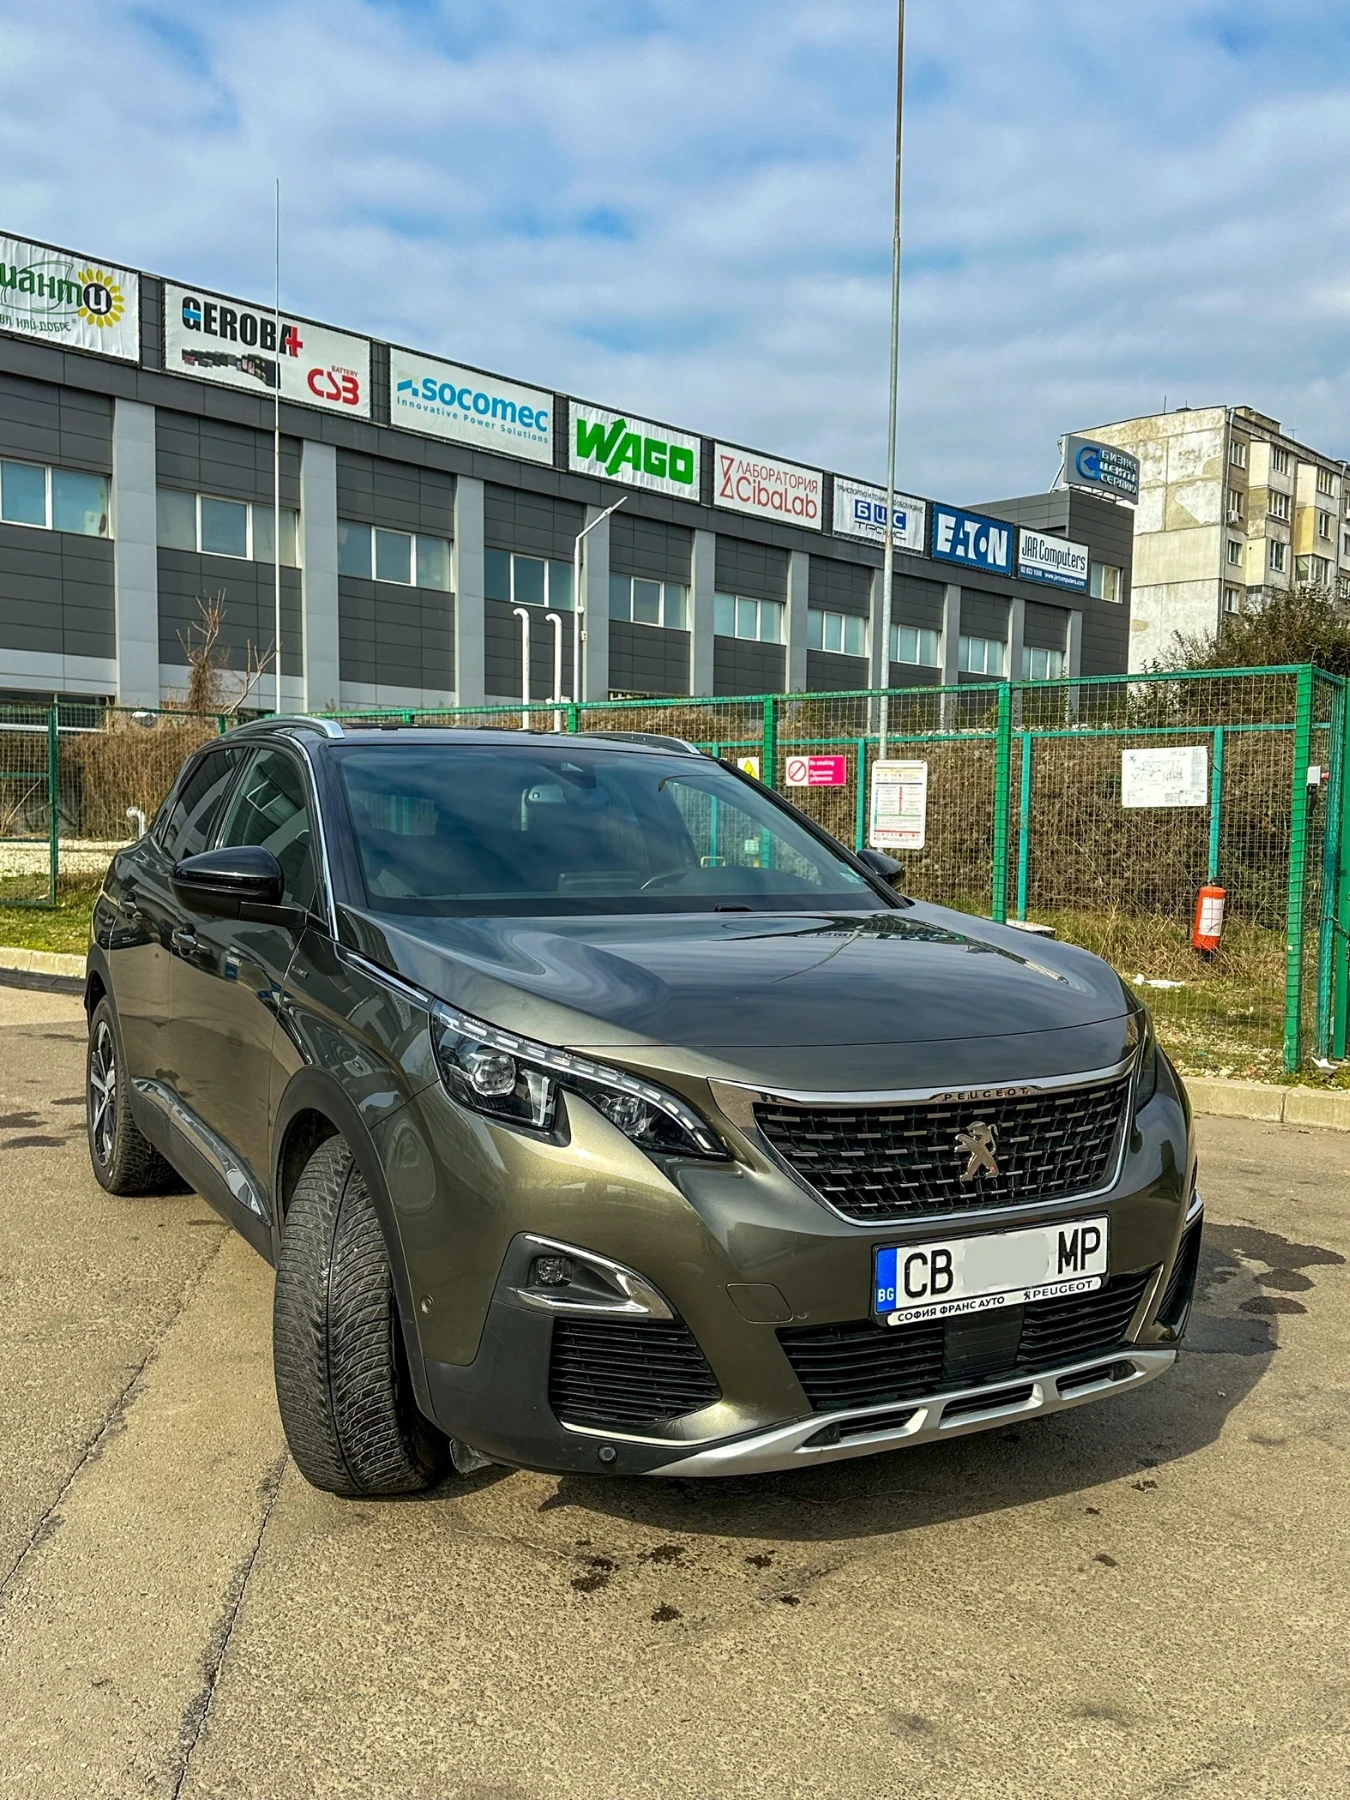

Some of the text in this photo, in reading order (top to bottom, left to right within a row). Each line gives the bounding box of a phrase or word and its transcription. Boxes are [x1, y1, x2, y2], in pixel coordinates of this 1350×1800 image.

[331, 365, 359, 378] BATTERY
[307, 368, 360, 406] CSB
[397, 396, 549, 444] Innovative Power Solutions
[576, 418, 694, 486] WAGO
[1101, 449, 1137, 472] БИЗНЕС
[736, 460, 818, 495] ЛАБОРАТОРИЯ
[1099, 461, 1137, 483] ЦЕНТЪР
[1100, 473, 1137, 494] СЕРДИКА
[735, 476, 818, 519] CibaLab
[856, 501, 905, 529] БЦС
[936, 512, 1009, 567] EATON
[1021, 534, 1086, 571] JAR Computers
[943, 1087, 1028, 1102] PEUGEOT
[878, 1288, 895, 1303] BG
[1032, 1280, 1094, 1299] PEUGEOT
[897, 1296, 1005, 1322] СОФИЯ ФРАНС АУТО
